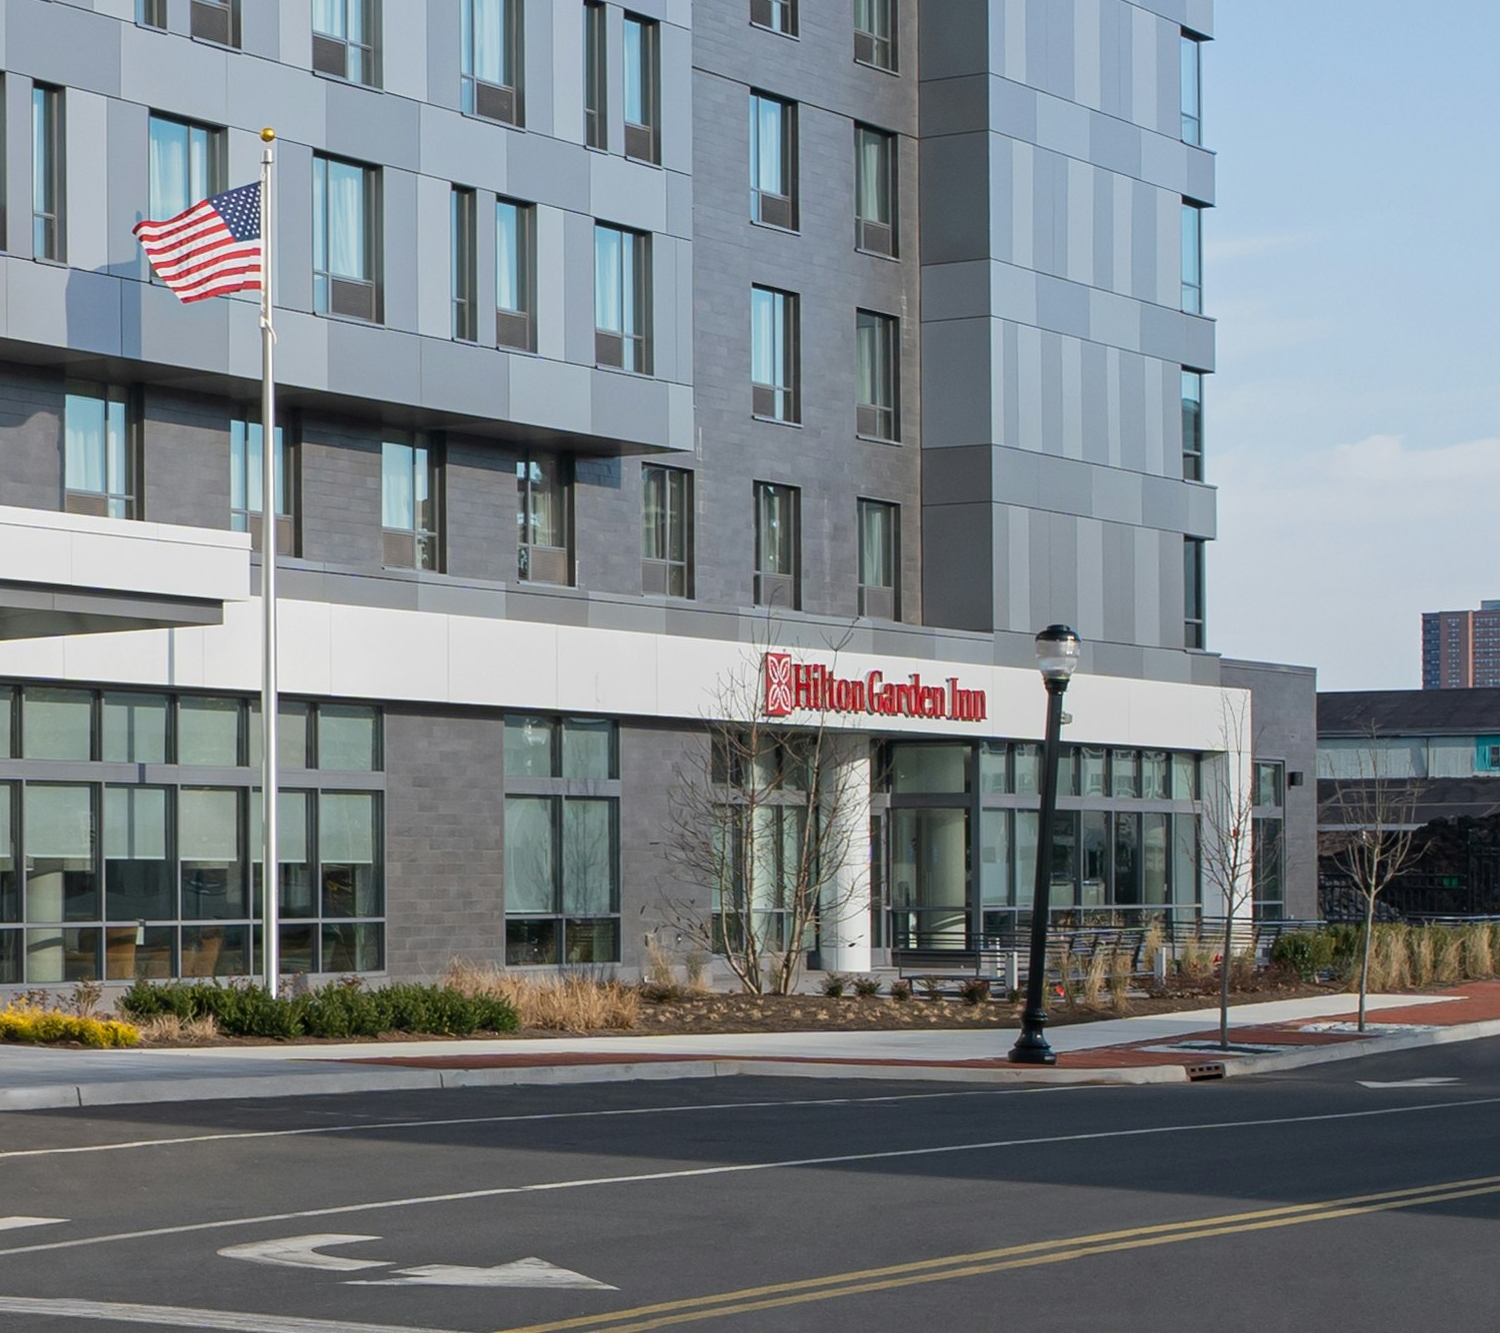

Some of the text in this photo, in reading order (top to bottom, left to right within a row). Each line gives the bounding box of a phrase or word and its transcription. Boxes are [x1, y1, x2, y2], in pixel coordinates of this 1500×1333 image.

[794, 664, 987, 721] Hilton Garden Inn
